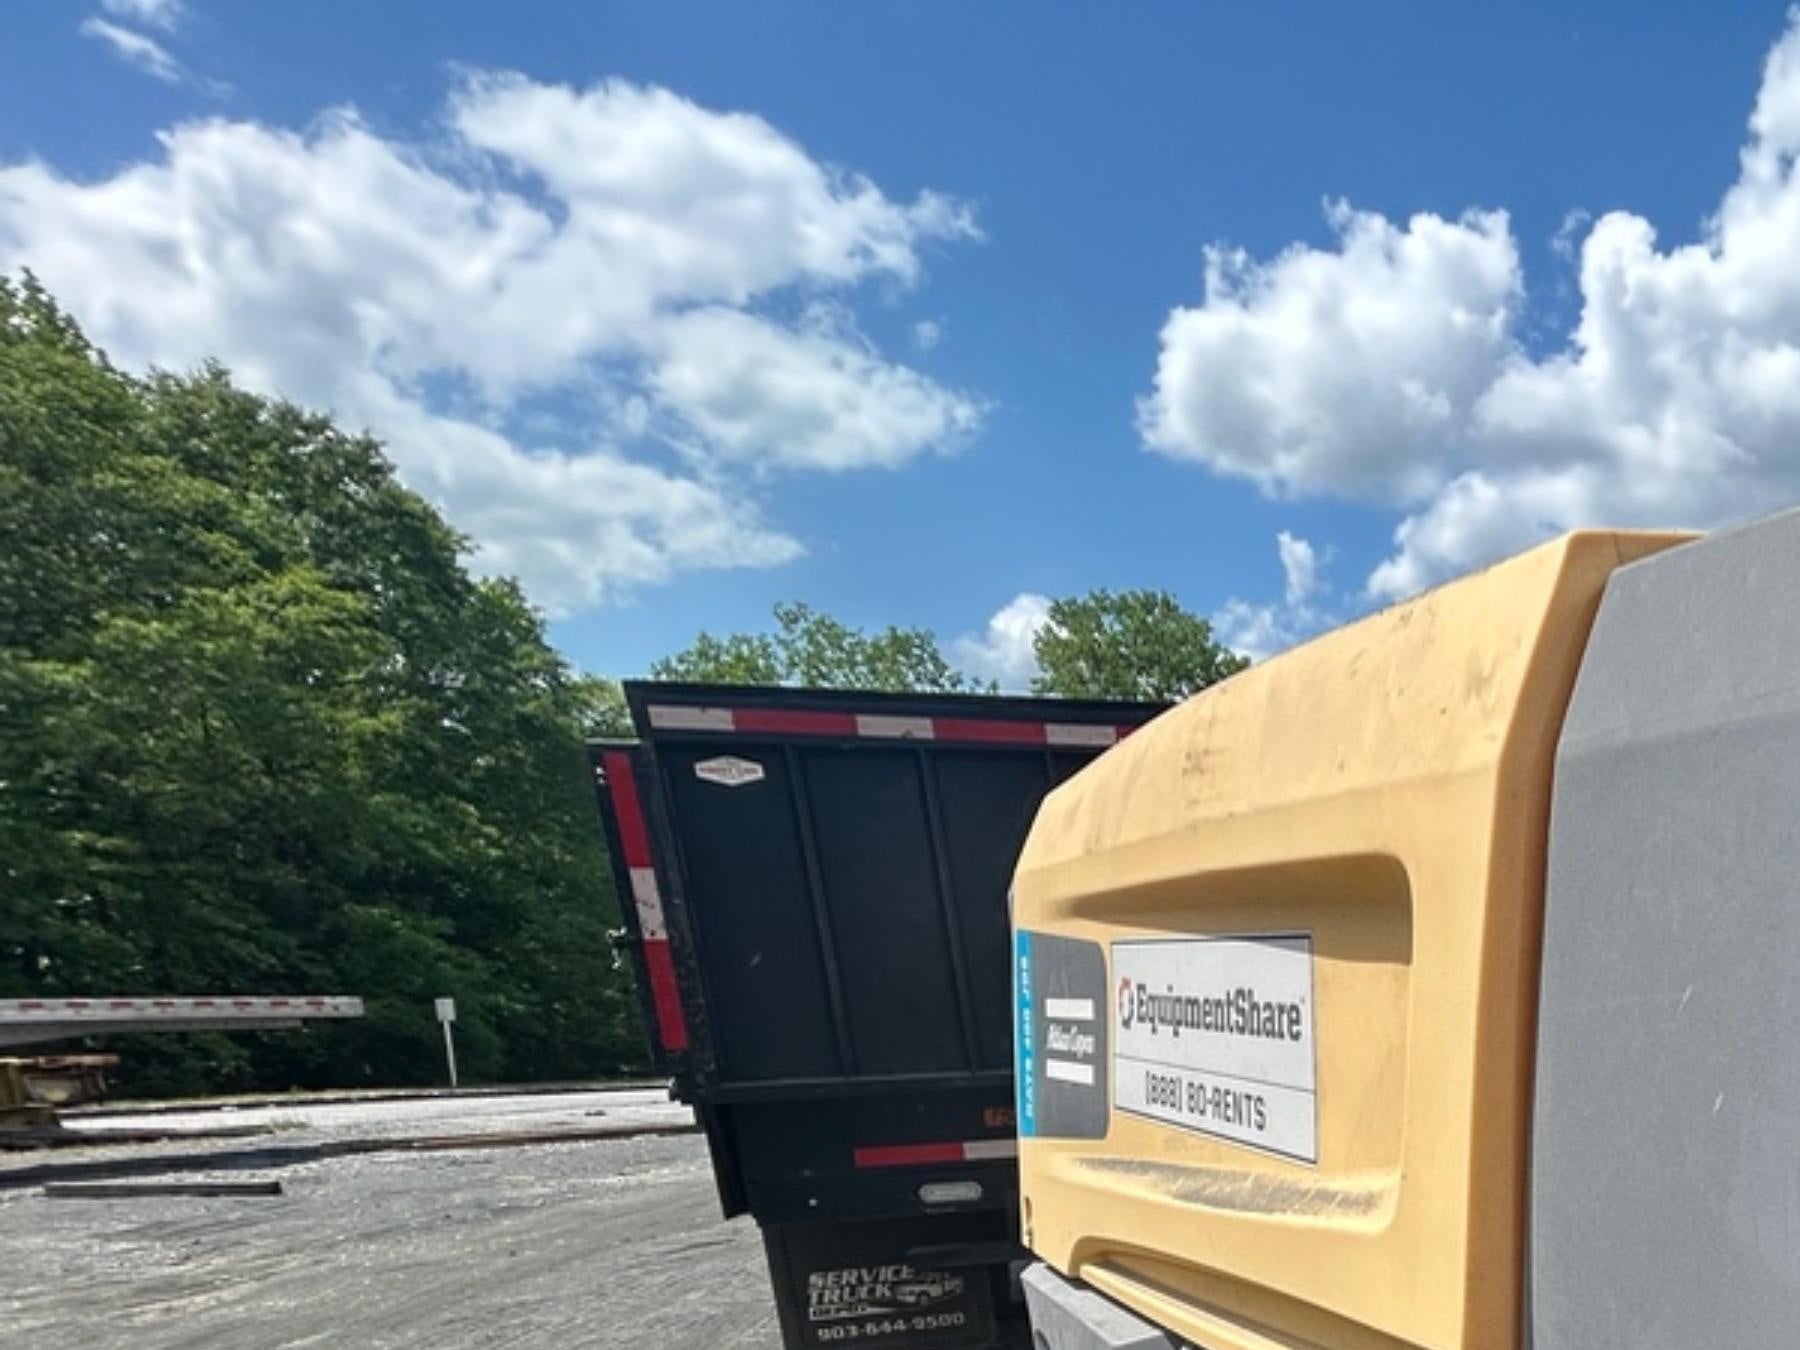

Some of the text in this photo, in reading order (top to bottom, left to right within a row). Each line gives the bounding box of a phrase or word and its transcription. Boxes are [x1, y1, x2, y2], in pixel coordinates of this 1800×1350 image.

[1136, 983, 1301, 1041] EquipmentShare
[1145, 1070, 1266, 1131] (888) 80-RENTS
[809, 1266, 915, 1288] SERVICE
[809, 1283, 893, 1306] TRUCK
